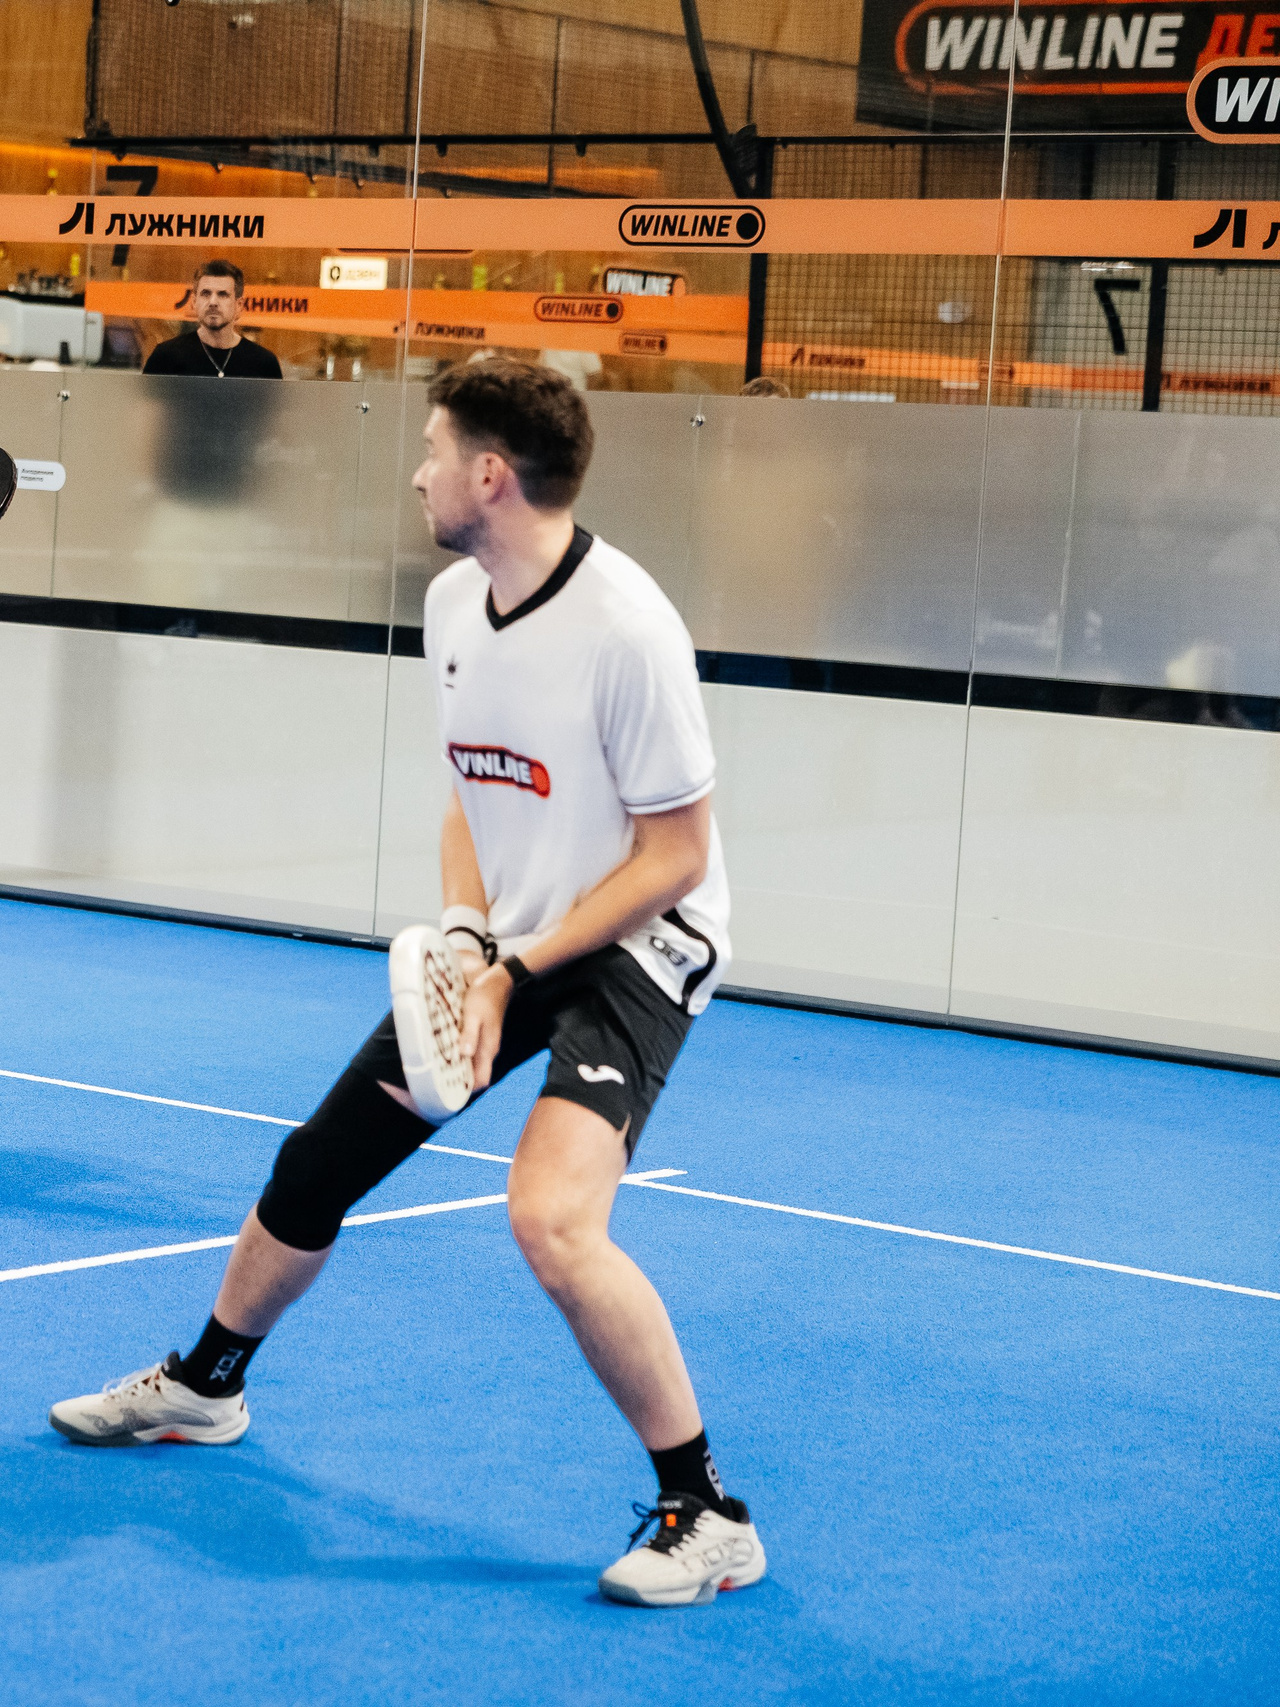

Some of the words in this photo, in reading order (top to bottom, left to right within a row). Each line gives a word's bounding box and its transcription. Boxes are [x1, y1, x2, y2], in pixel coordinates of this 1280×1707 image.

[925, 13, 1184, 70] WINLINE
[105, 213, 265, 239] ЛУЖНИКИ
[630, 214, 733, 237] WINLINE
[243, 297, 309, 313] НИКИ
[540, 302, 603, 317] WINLINE
